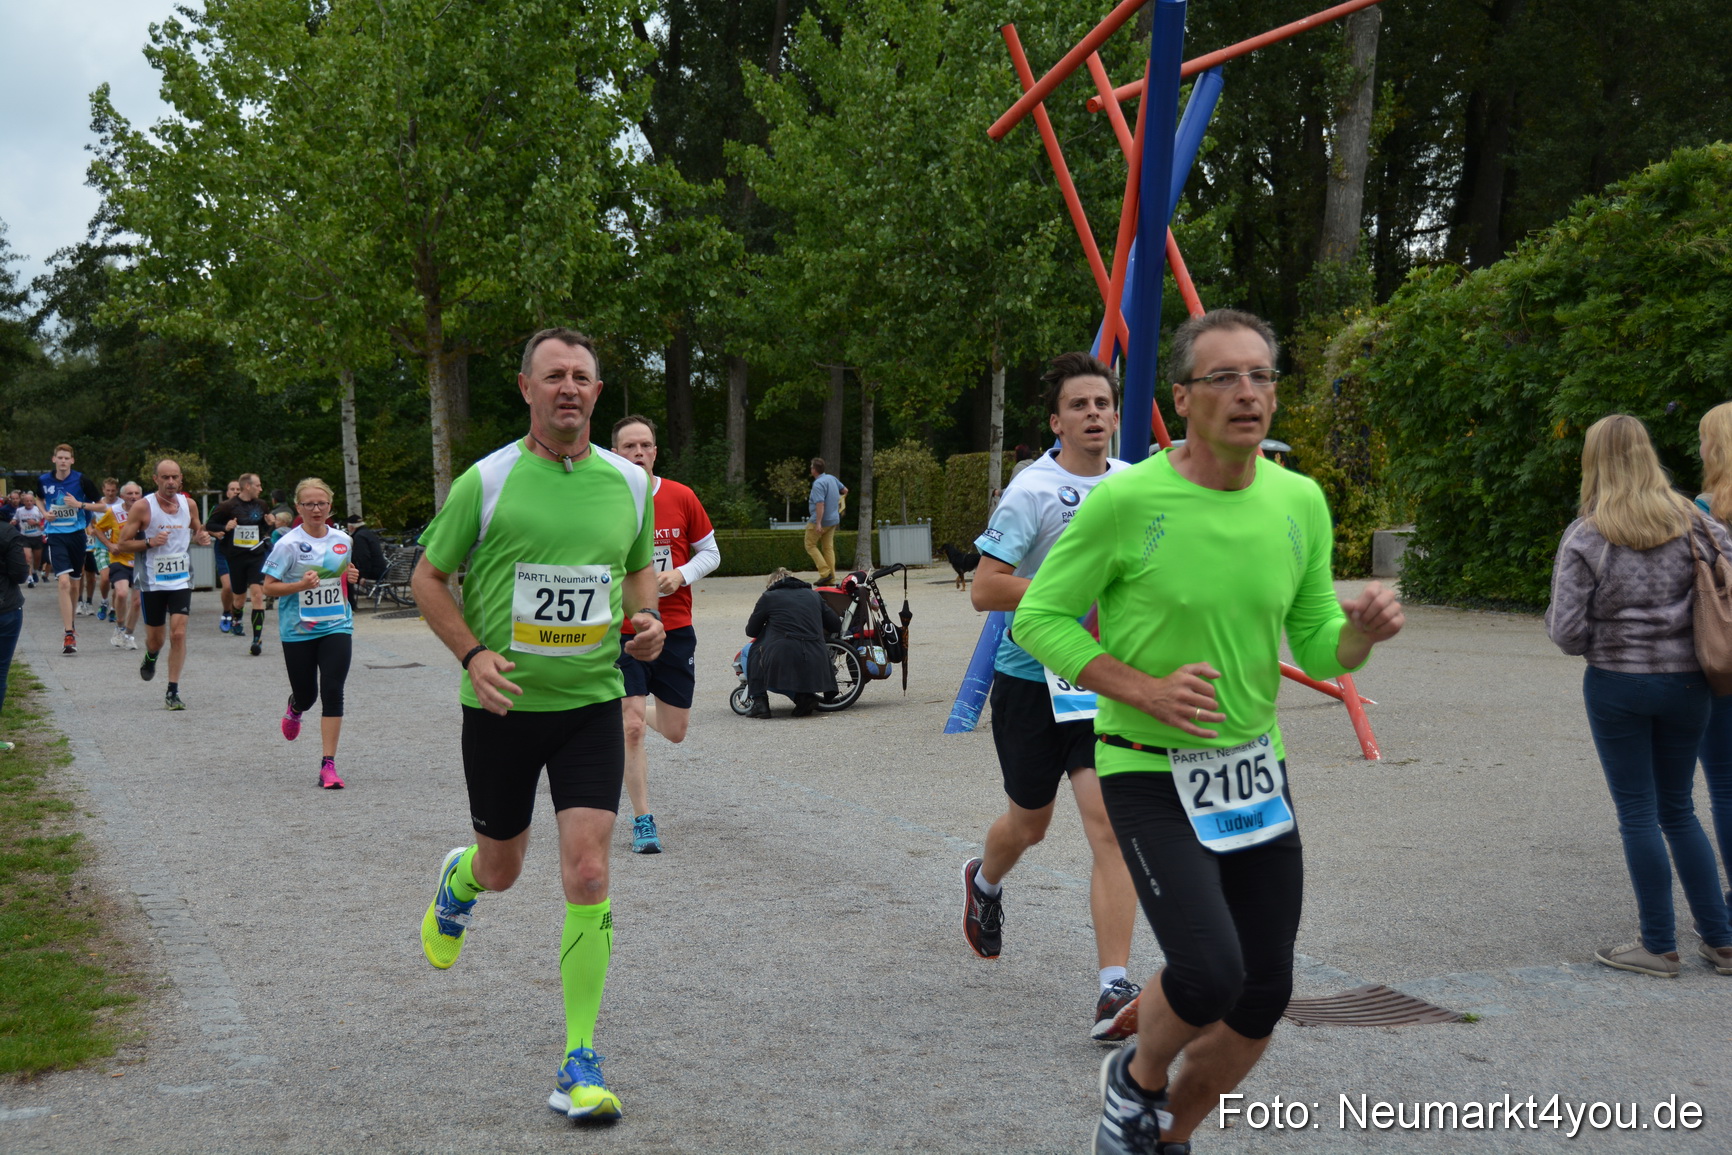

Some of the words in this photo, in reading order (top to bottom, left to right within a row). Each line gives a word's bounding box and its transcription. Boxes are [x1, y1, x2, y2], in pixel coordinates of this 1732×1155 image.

[43, 485, 55, 494] 14
[52, 509, 74, 518] 2030
[240, 531, 255, 540] 124
[654, 529, 670, 538] KT
[157, 560, 185, 573] 2411
[653, 558, 667, 571] 7
[518, 571, 551, 583] PARTL
[553, 575, 598, 584] Neumarkt
[304, 588, 340, 606] 3102
[534, 588, 595, 622] 257
[539, 630, 587, 644] Werner
[1172, 750, 1214, 765] PARTL
[1216, 740, 1257, 759] Neumarkt
[1189, 753, 1275, 809] 2105
[1215, 810, 1264, 834] Ludwig
